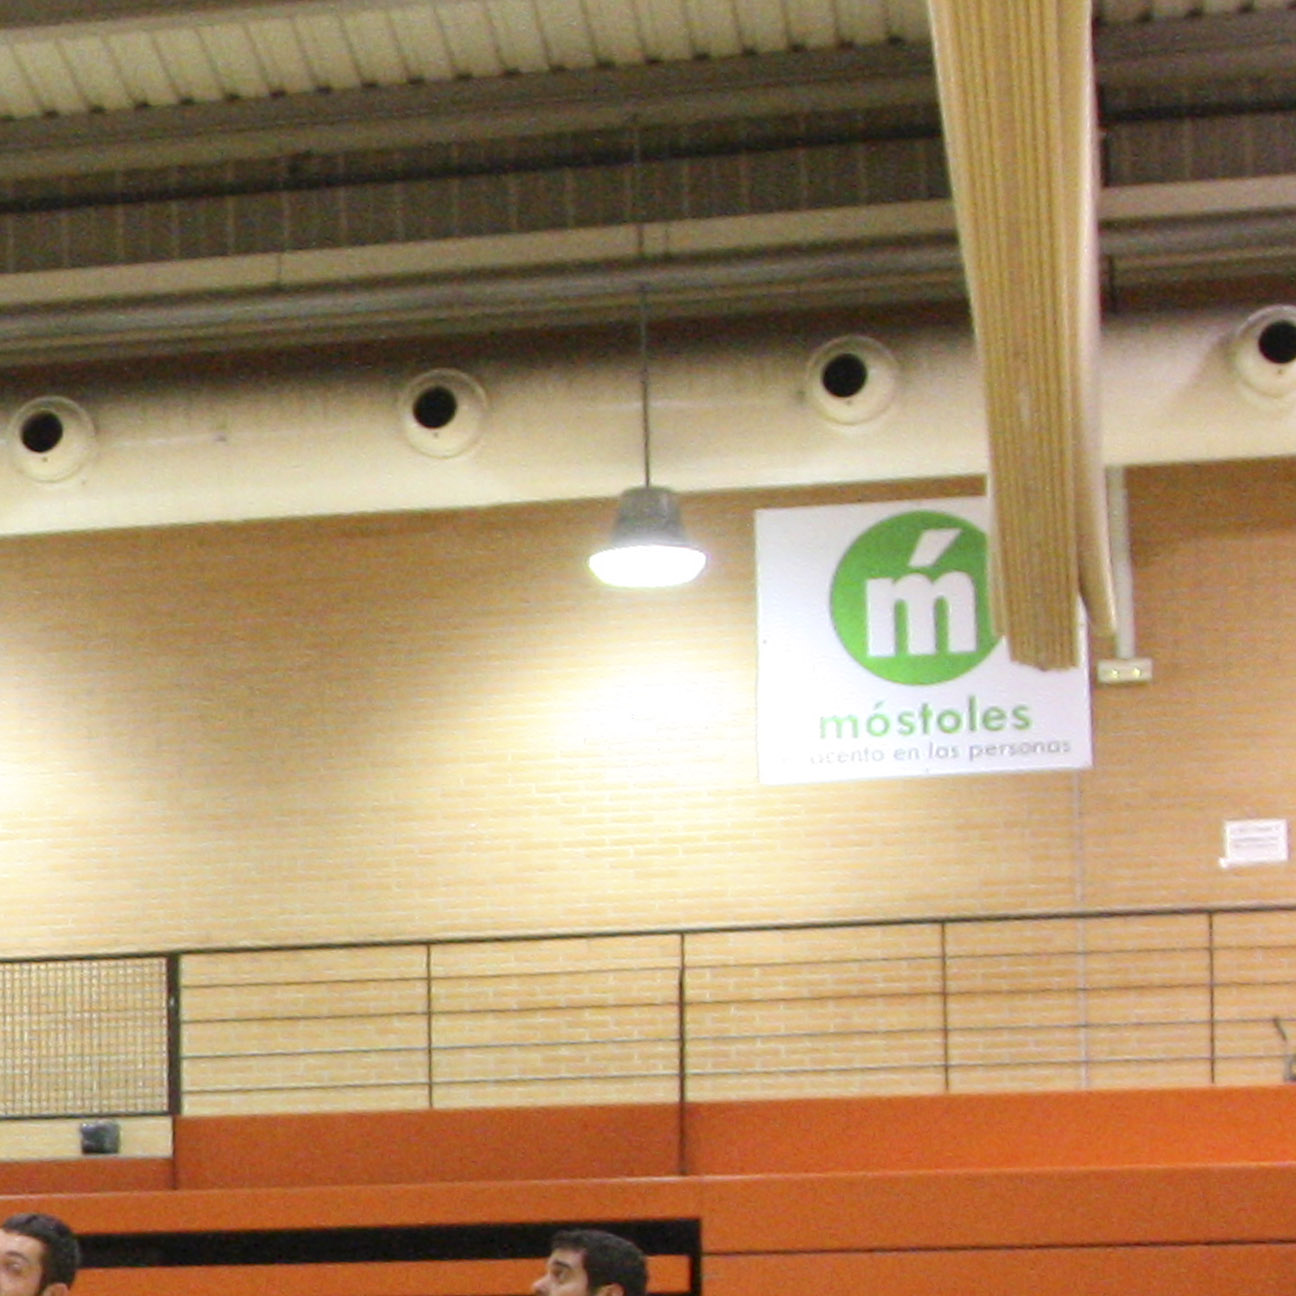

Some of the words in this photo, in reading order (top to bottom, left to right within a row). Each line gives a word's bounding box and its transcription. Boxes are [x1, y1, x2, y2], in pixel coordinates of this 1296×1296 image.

[819, 695, 1033, 739] móstoles
[893, 744, 920, 762] en
[927, 741, 960, 760] las
[968, 737, 1073, 763] personas
